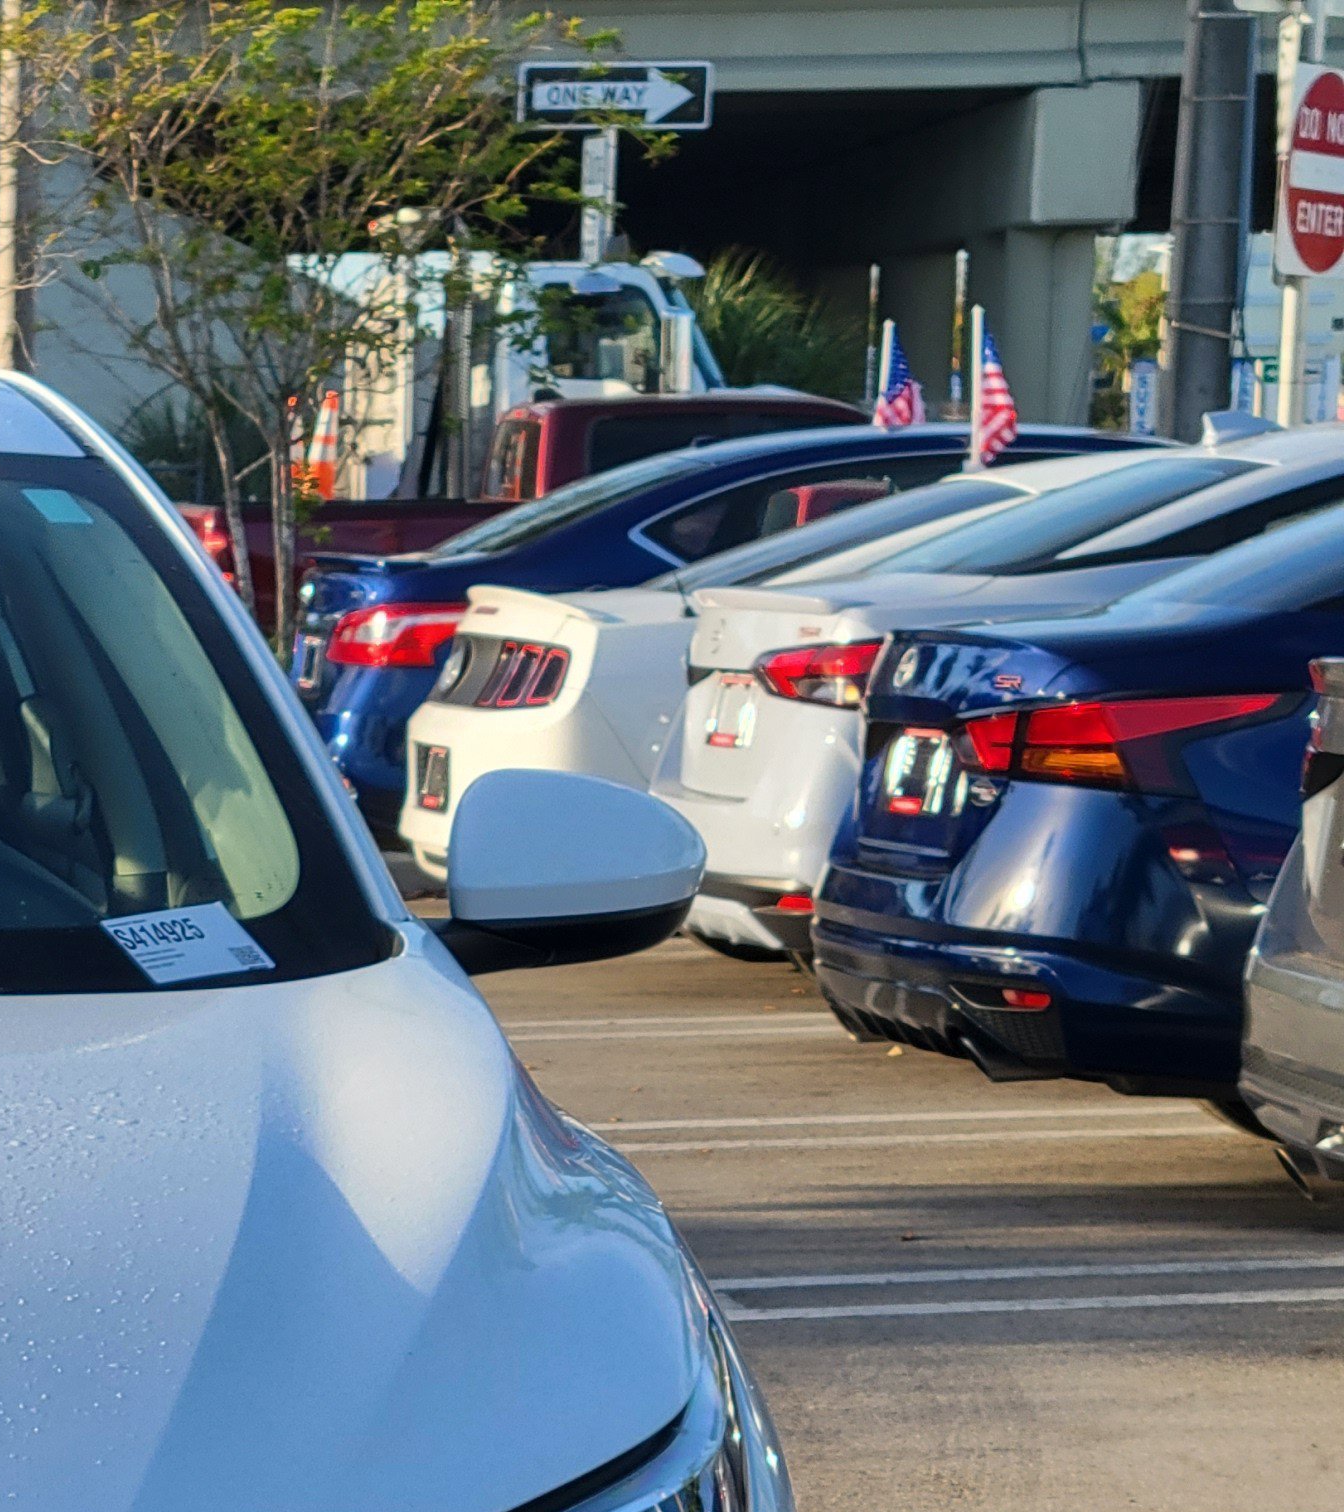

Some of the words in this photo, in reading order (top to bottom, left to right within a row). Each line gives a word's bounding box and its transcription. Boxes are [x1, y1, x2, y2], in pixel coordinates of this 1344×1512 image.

[546, 86, 594, 105] ONE
[600, 86, 647, 106] WAY
[1299, 106, 1321, 140] DO
[1296, 199, 1344, 237] ENTER
[994, 674, 1023, 690] SR
[113, 917, 205, 951] S414925
